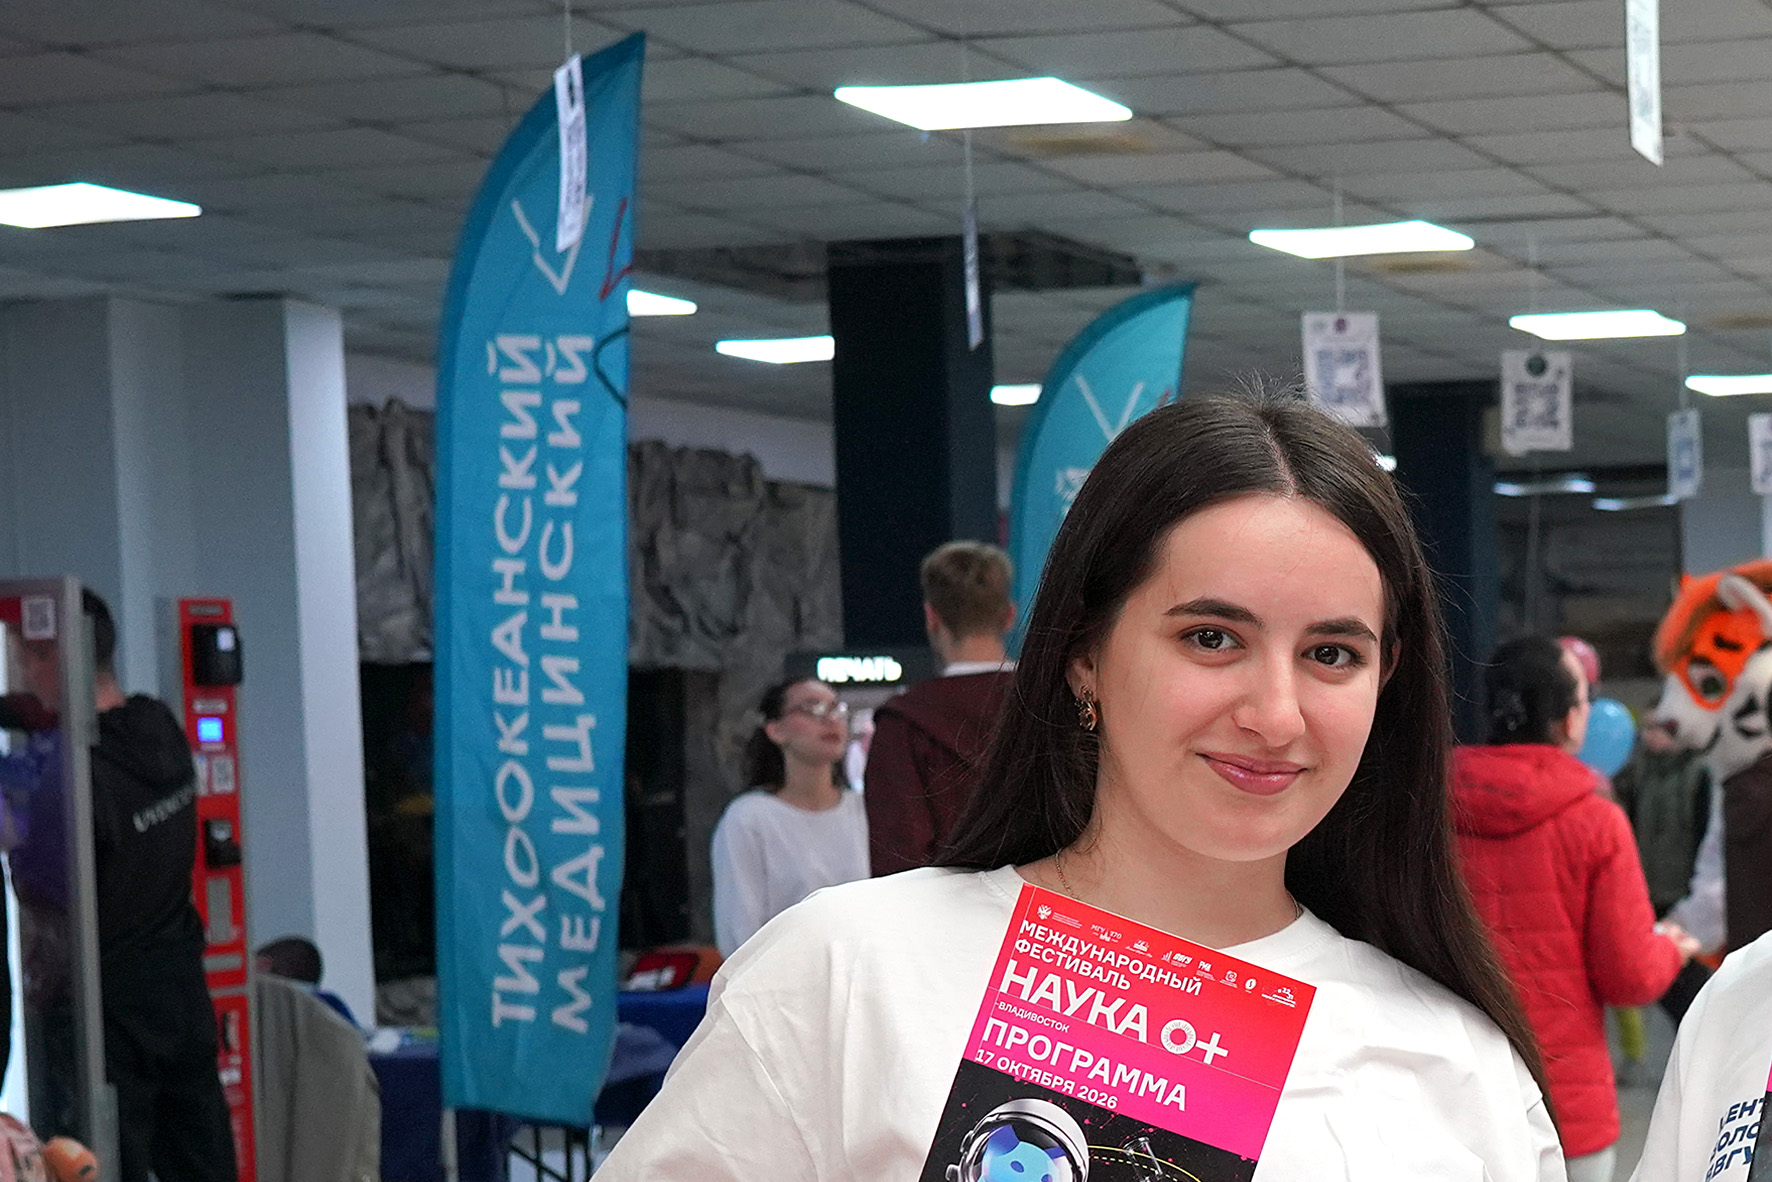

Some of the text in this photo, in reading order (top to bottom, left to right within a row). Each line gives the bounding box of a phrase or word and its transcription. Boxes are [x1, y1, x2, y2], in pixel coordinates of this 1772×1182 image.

[488, 334, 547, 1029] ТИХООКЕАНСКИЙ
[537, 335, 605, 1034] МЕДИЦИНСКИЙ
[1015, 938, 1131, 991] ФЕСТИВАЛЬ
[1018, 919, 1202, 996] МЕЖДУНАРОДНЫЙ
[1000, 960, 1148, 1043] НАУКА
[975, 1048, 1118, 1109] 17 ОКТЯБРЯ 2026
[982, 1017, 1186, 1112] ПРОГРАММА
